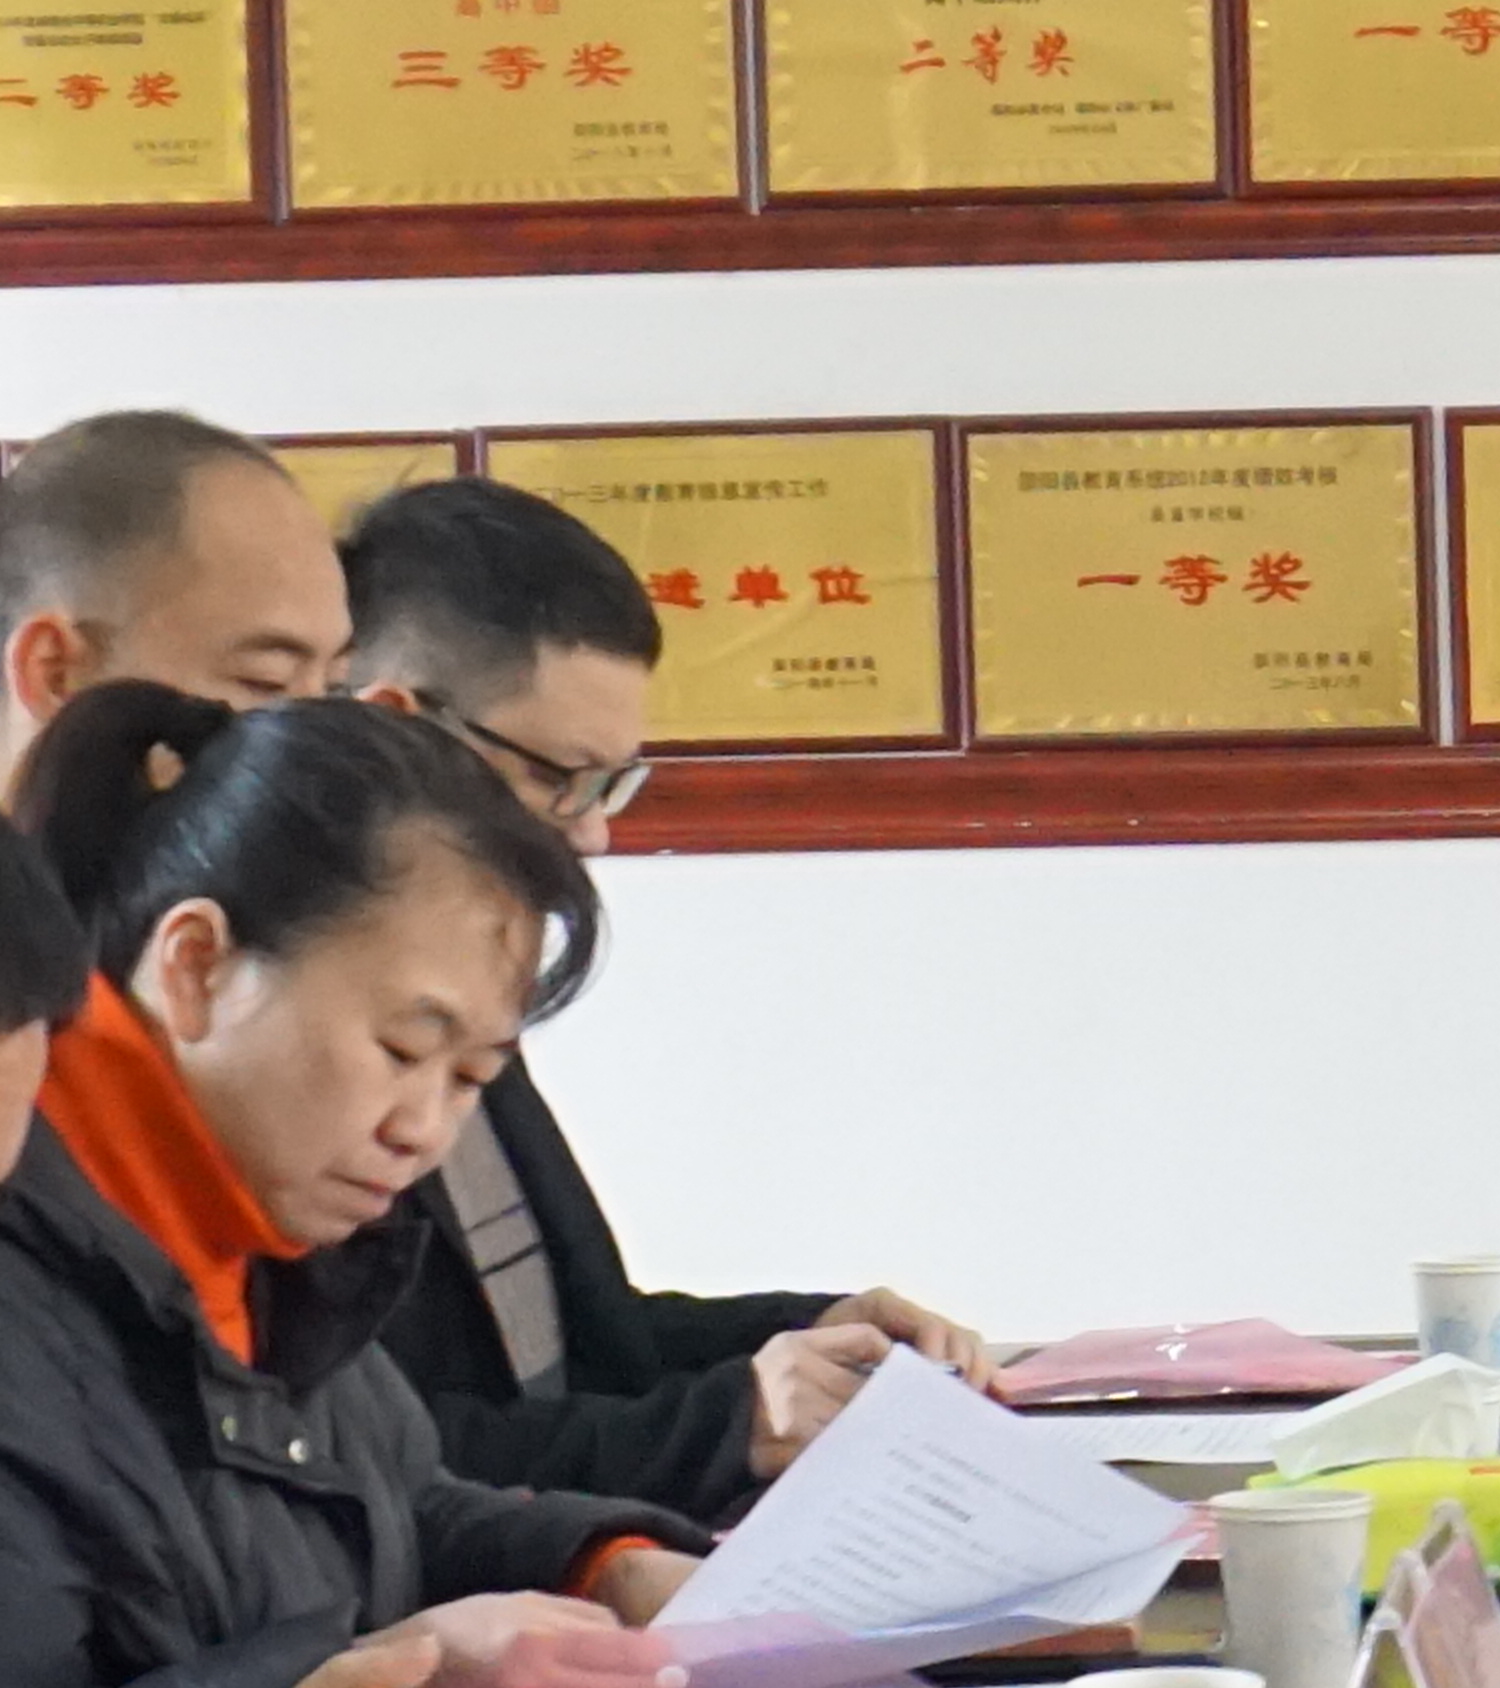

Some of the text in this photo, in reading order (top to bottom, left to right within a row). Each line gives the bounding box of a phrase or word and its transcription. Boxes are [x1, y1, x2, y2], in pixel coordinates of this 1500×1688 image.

[391, 42, 633, 91] 三等奖
[900, 26, 1074, 84] 二等奖
[1077, 551, 1312, 606] 一等奖
